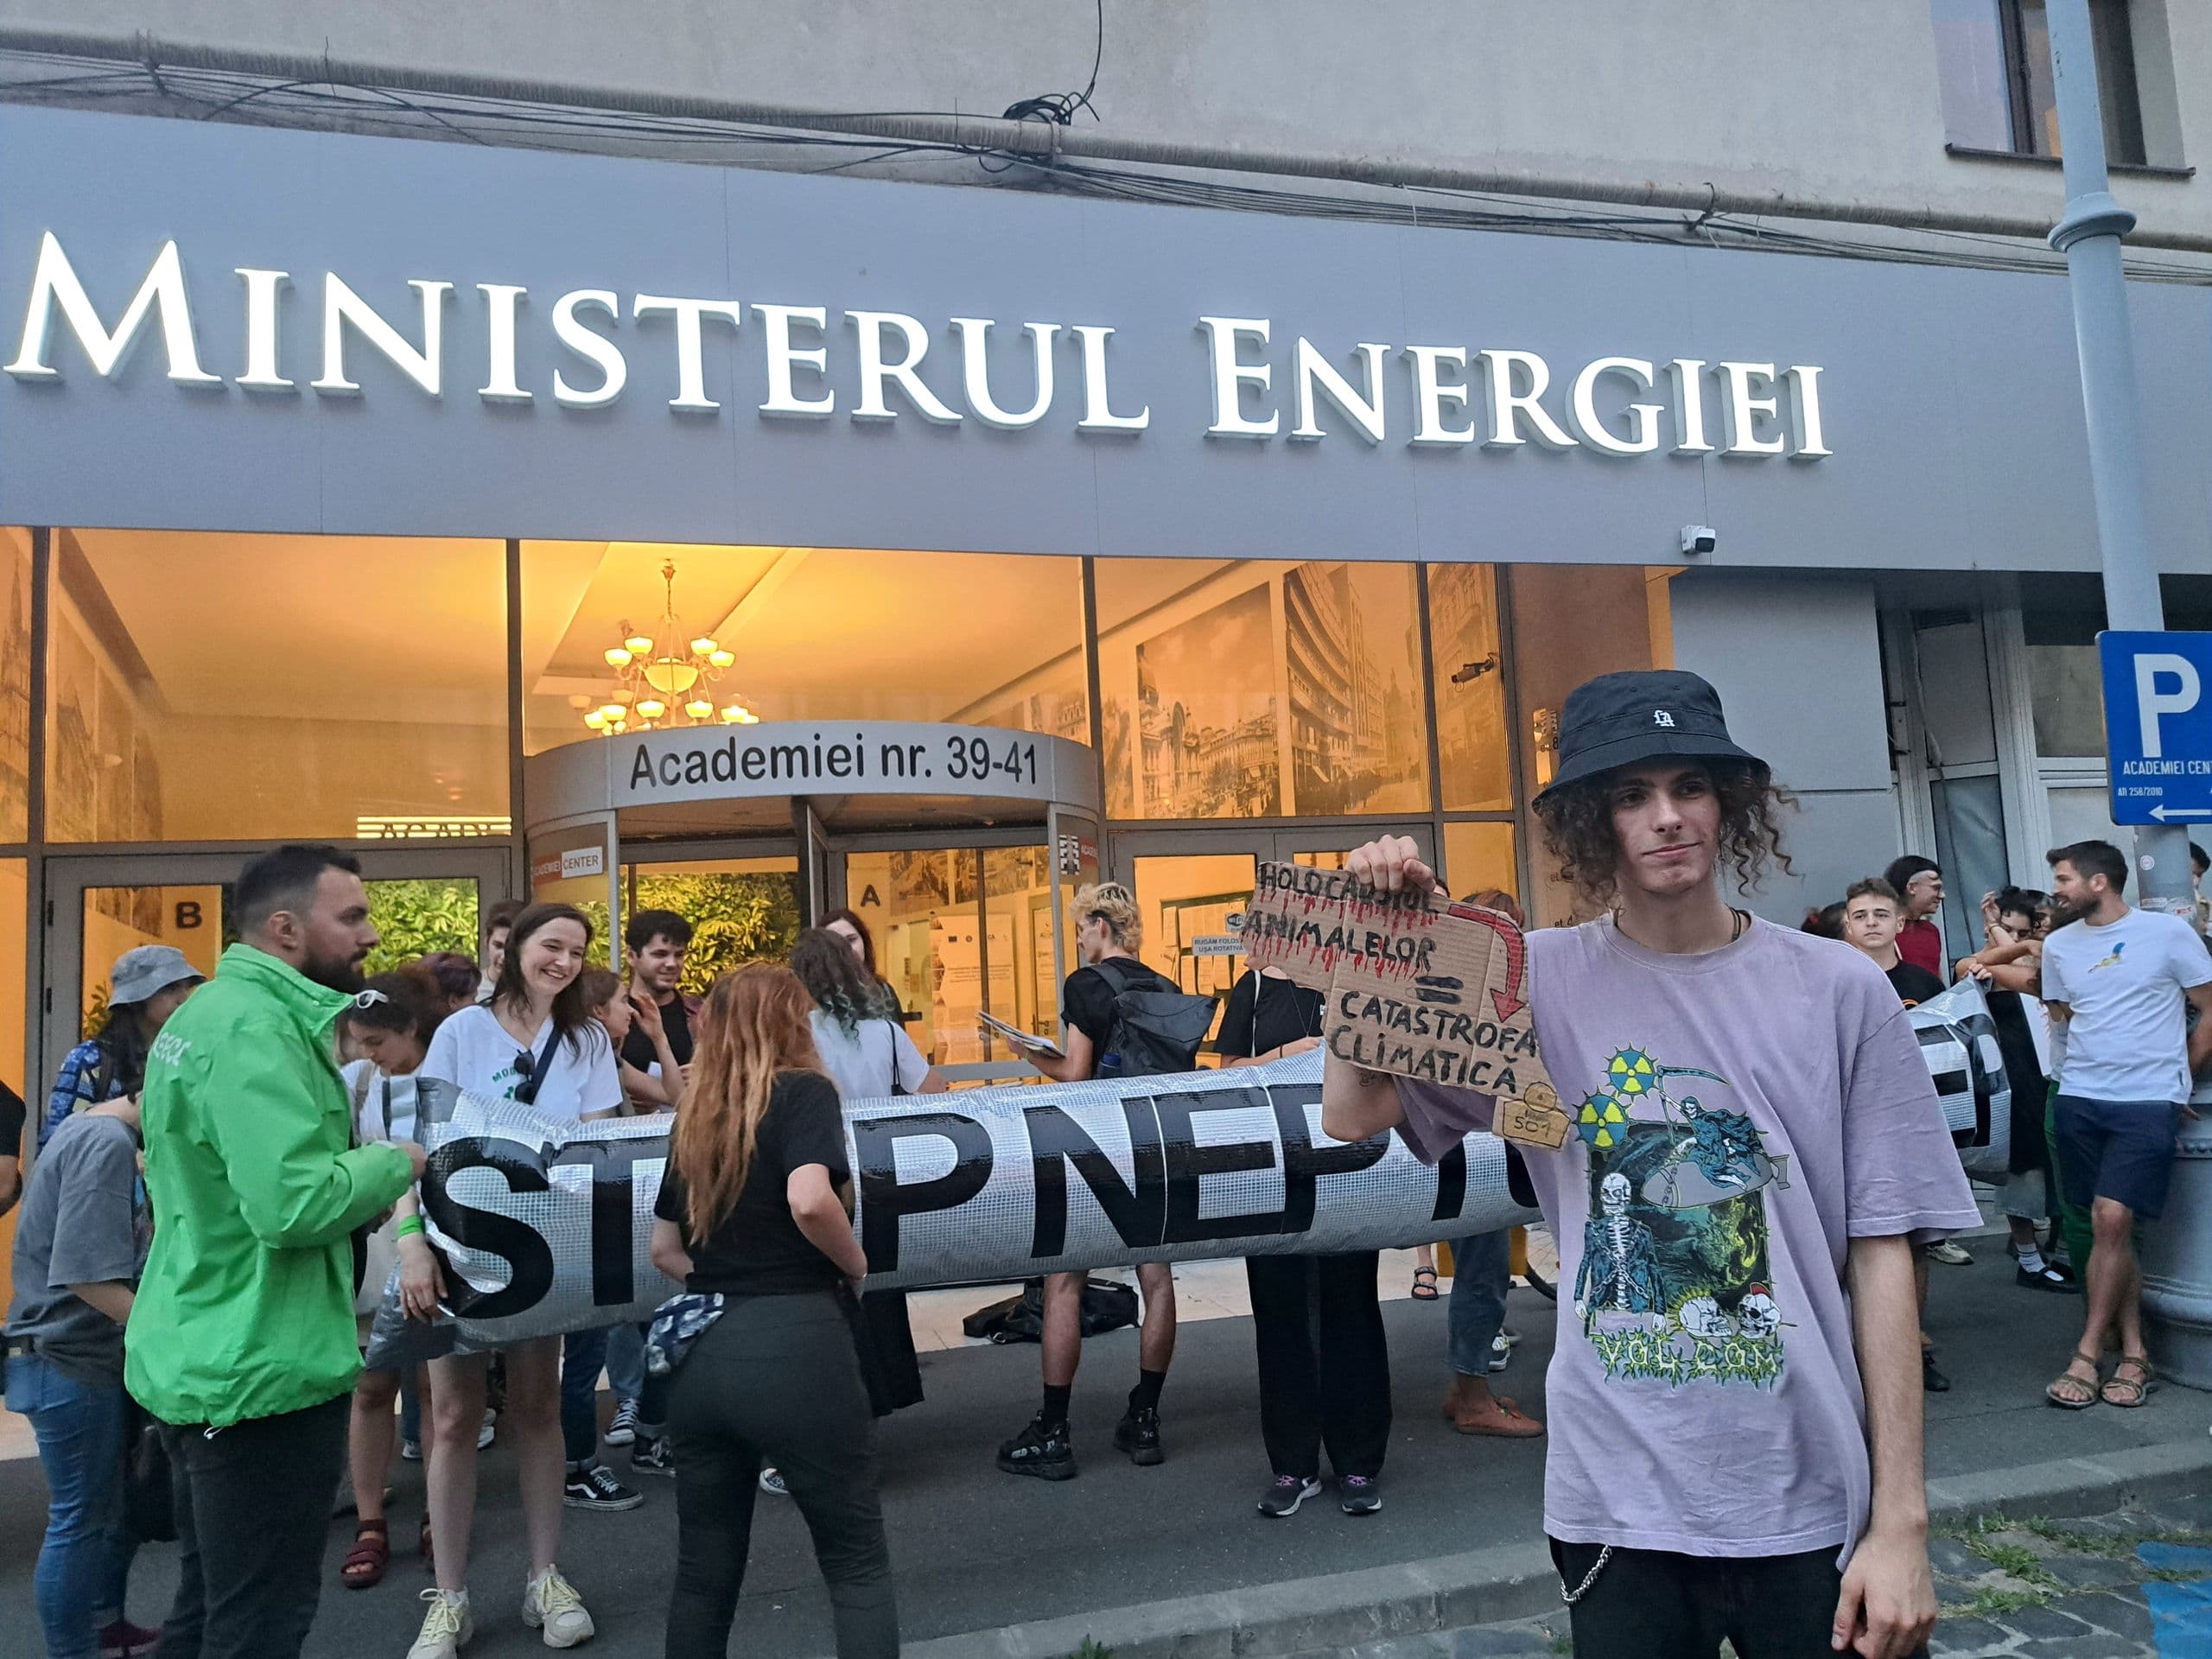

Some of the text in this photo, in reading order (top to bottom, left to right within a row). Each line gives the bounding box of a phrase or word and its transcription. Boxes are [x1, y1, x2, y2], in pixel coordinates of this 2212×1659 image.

[3, 230, 1834, 460] MINISTERUL ENERGIEI
[2133, 653, 2201, 758] P
[630, 731, 1037, 790] Academiei nr. 39-41
[2123, 760, 2184, 775] ACADEMIEI
[563, 855, 599, 870] CENTER
[175, 900, 202, 929] B
[860, 884, 880, 907] A
[1242, 910, 1437, 971] ANIMALELOR
[1340, 990, 1537, 1058] CATASTROFA
[421, 1112, 994, 1319] STP
[1594, 1328, 1783, 1388] VOLCOM
